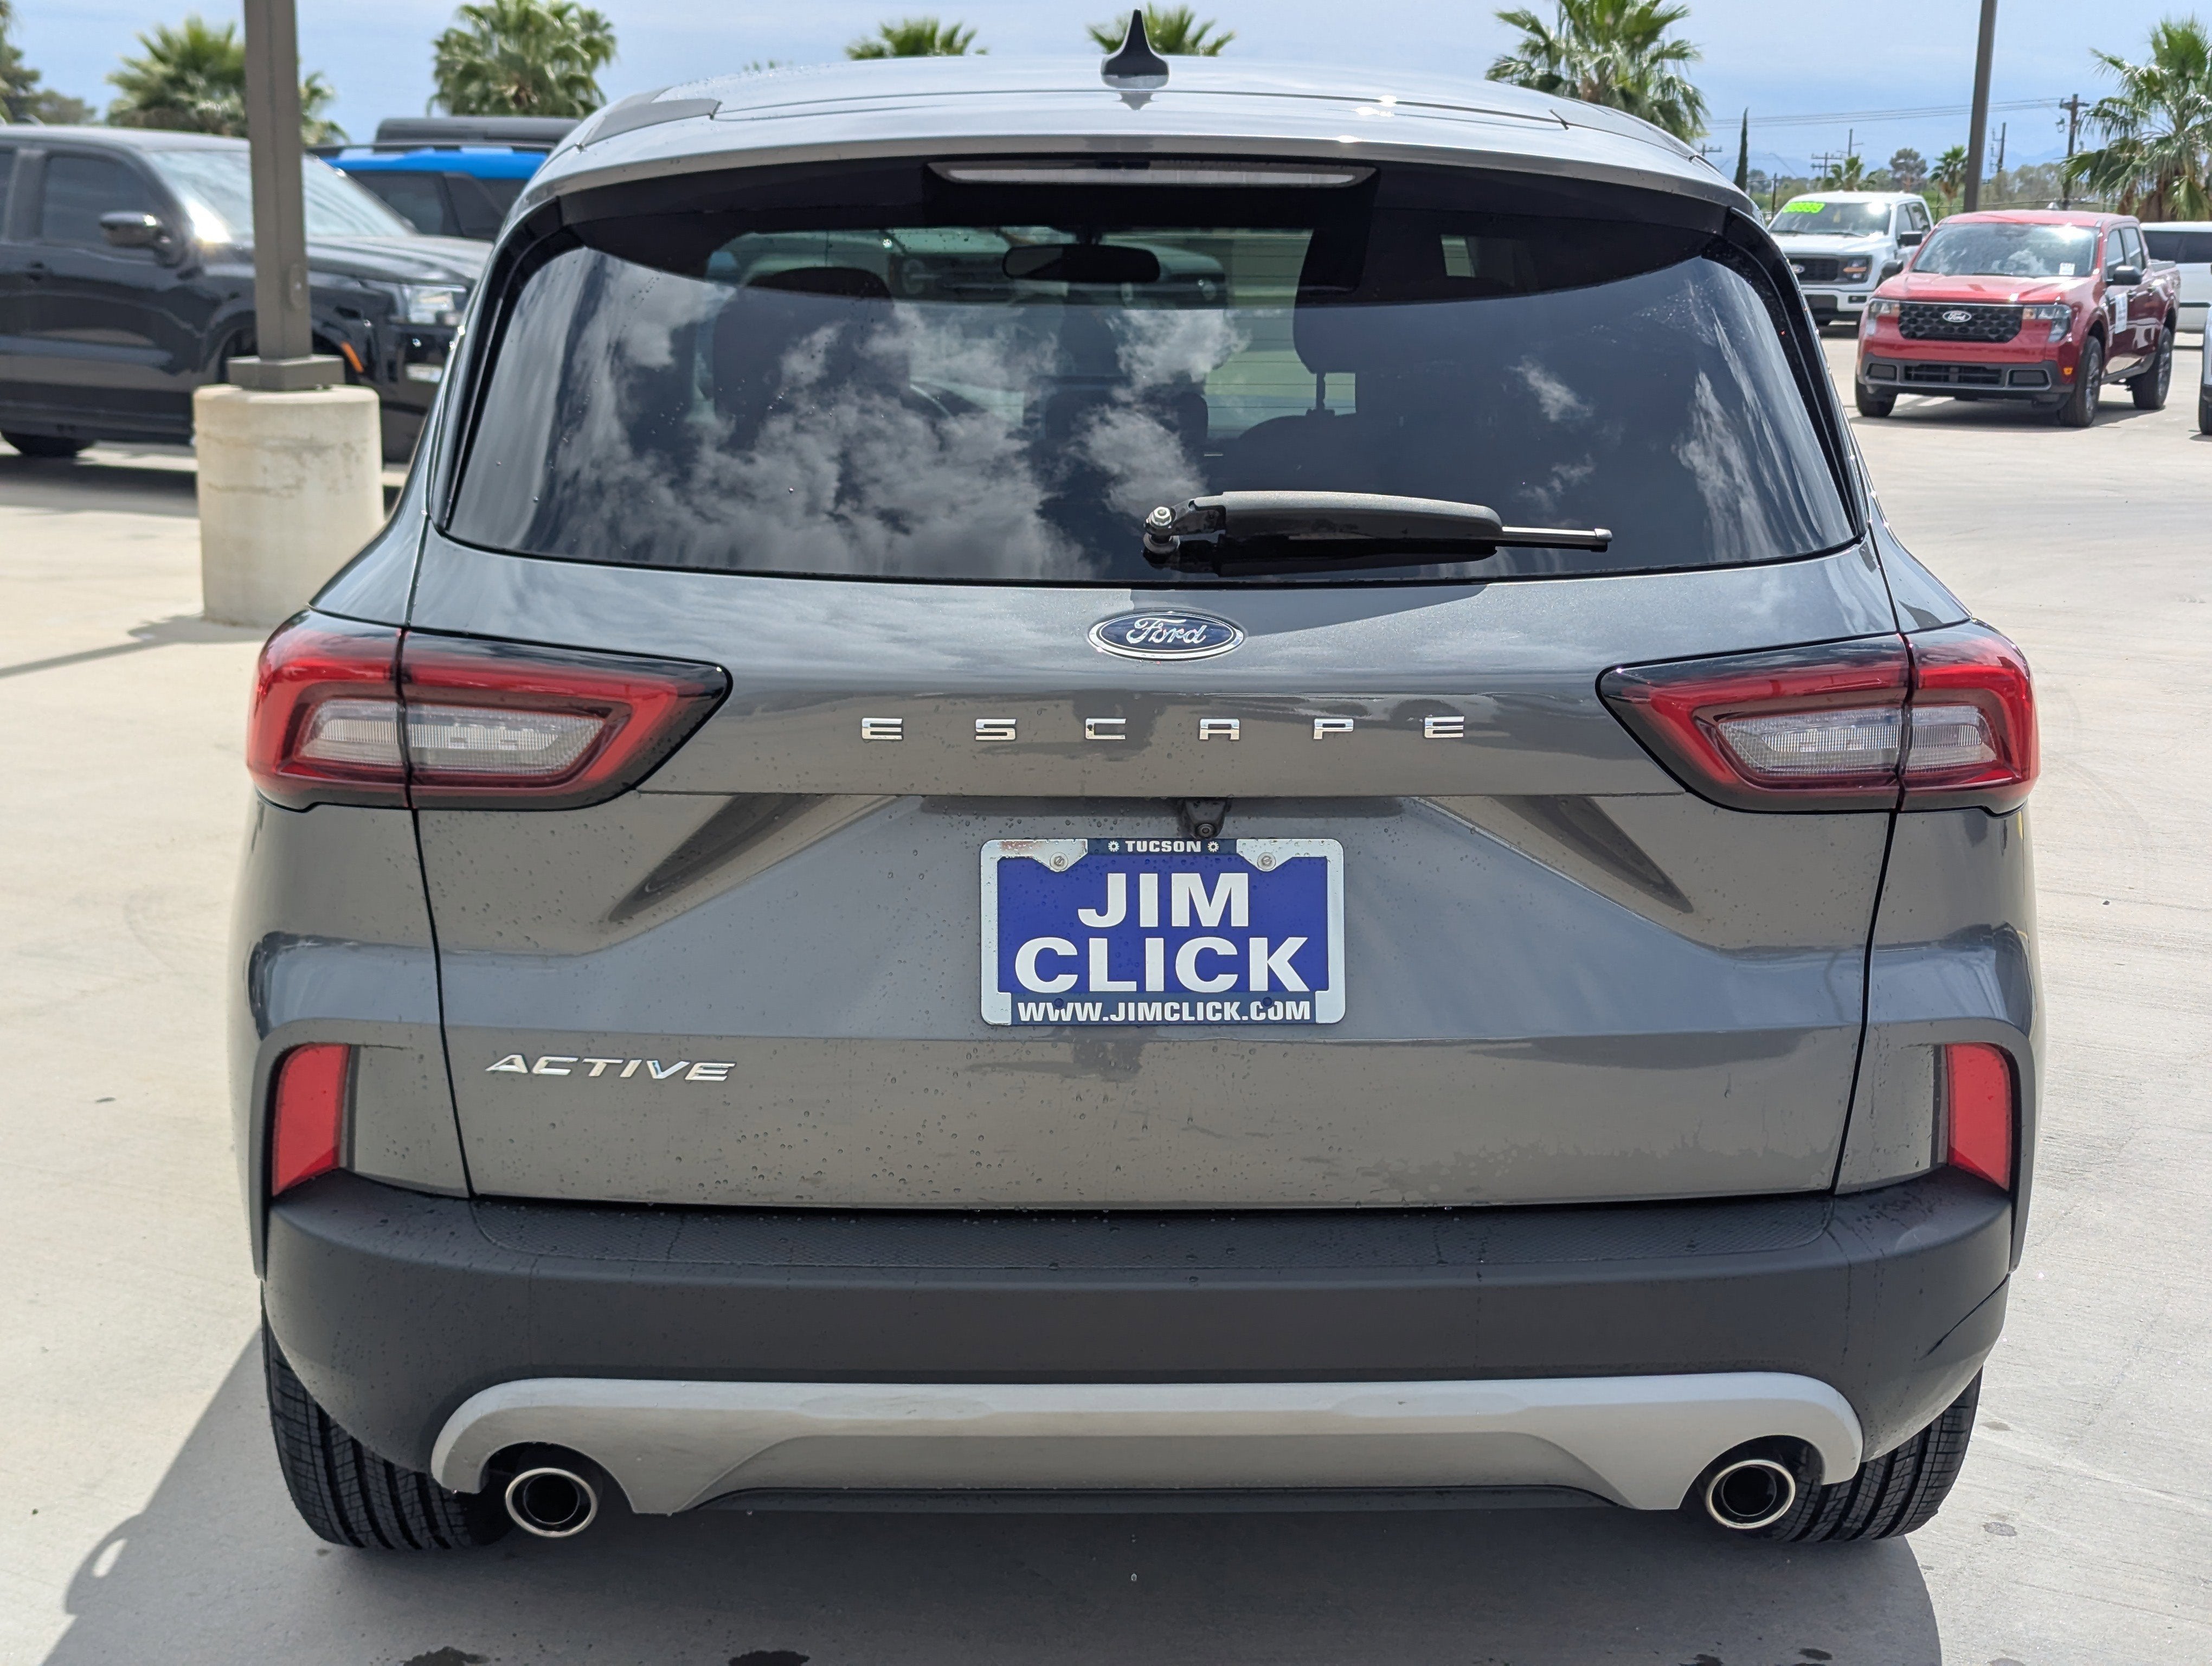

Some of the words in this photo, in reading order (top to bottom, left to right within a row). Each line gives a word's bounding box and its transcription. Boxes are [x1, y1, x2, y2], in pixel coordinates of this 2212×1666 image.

[1126, 617, 1207, 644] Ford
[860, 715, 1466, 741] ESCAPE
[1125, 840, 1202, 853] TUCSON
[1077, 873, 1249, 927] JIM
[1015, 937, 1310, 993] CLICK
[1017, 1001, 1311, 1022] WWW.JIMCLICK.COM
[485, 1053, 738, 1082] ACTIVE
